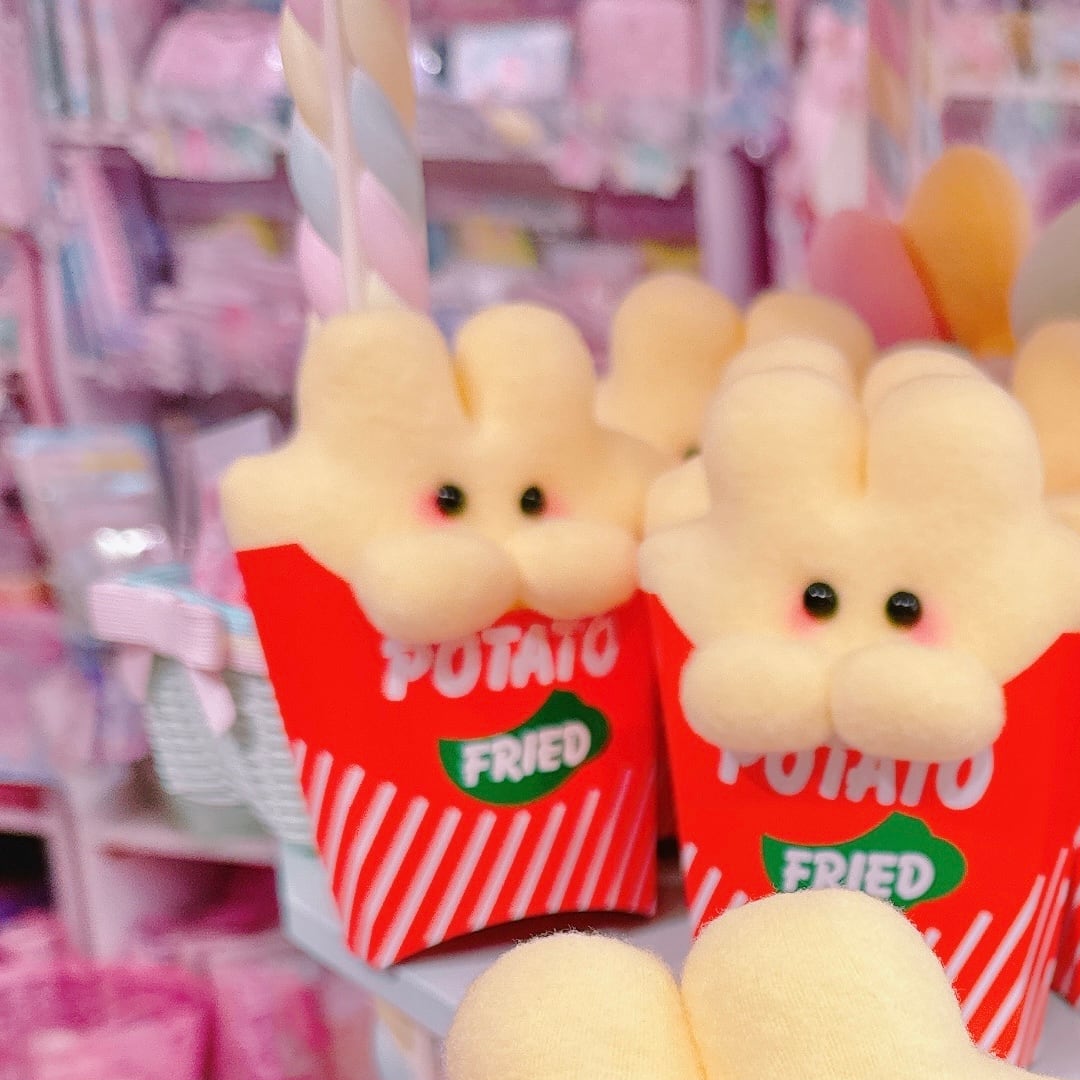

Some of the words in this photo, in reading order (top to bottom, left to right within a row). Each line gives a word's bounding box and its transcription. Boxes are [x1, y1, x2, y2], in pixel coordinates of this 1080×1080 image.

[380, 616, 619, 702] POTATO
[461, 719, 592, 788] FRIED
[781, 848, 936, 901] FRIED
